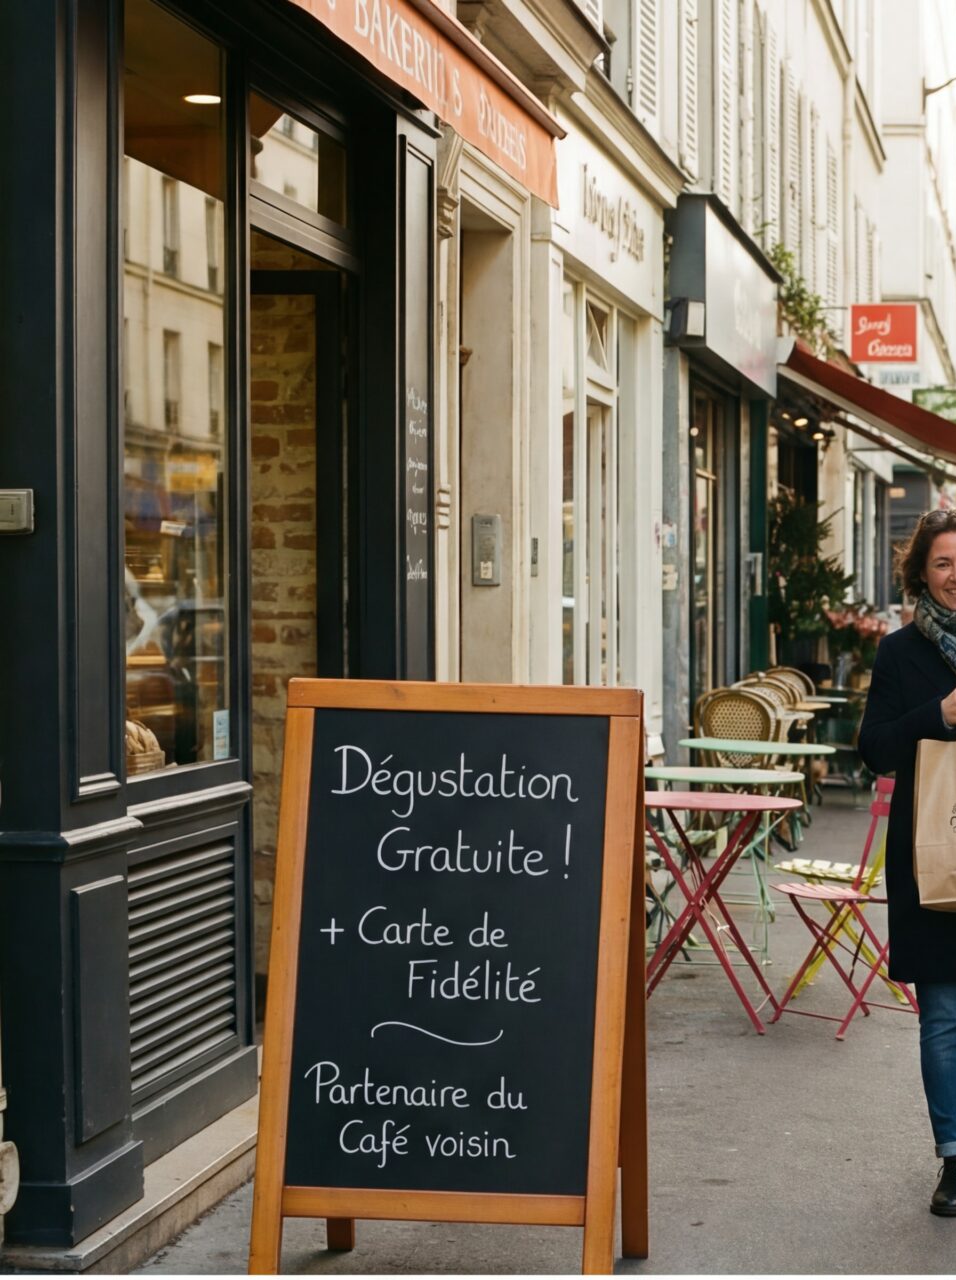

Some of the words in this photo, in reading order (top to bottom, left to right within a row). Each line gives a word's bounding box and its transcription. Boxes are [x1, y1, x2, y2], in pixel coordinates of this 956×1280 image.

[331, 745, 579, 818] Dégustation
[377, 827, 549, 876] Gratuite
[358, 906, 454, 946] Carte
[468, 911, 508, 948] de
[408, 959, 541, 1003] Fidélité
[304, 1061, 470, 1109] Partenaire
[487, 1076, 528, 1110] du
[339, 1119, 411, 1168] Café
[425, 1131, 516, 1159] voisin
